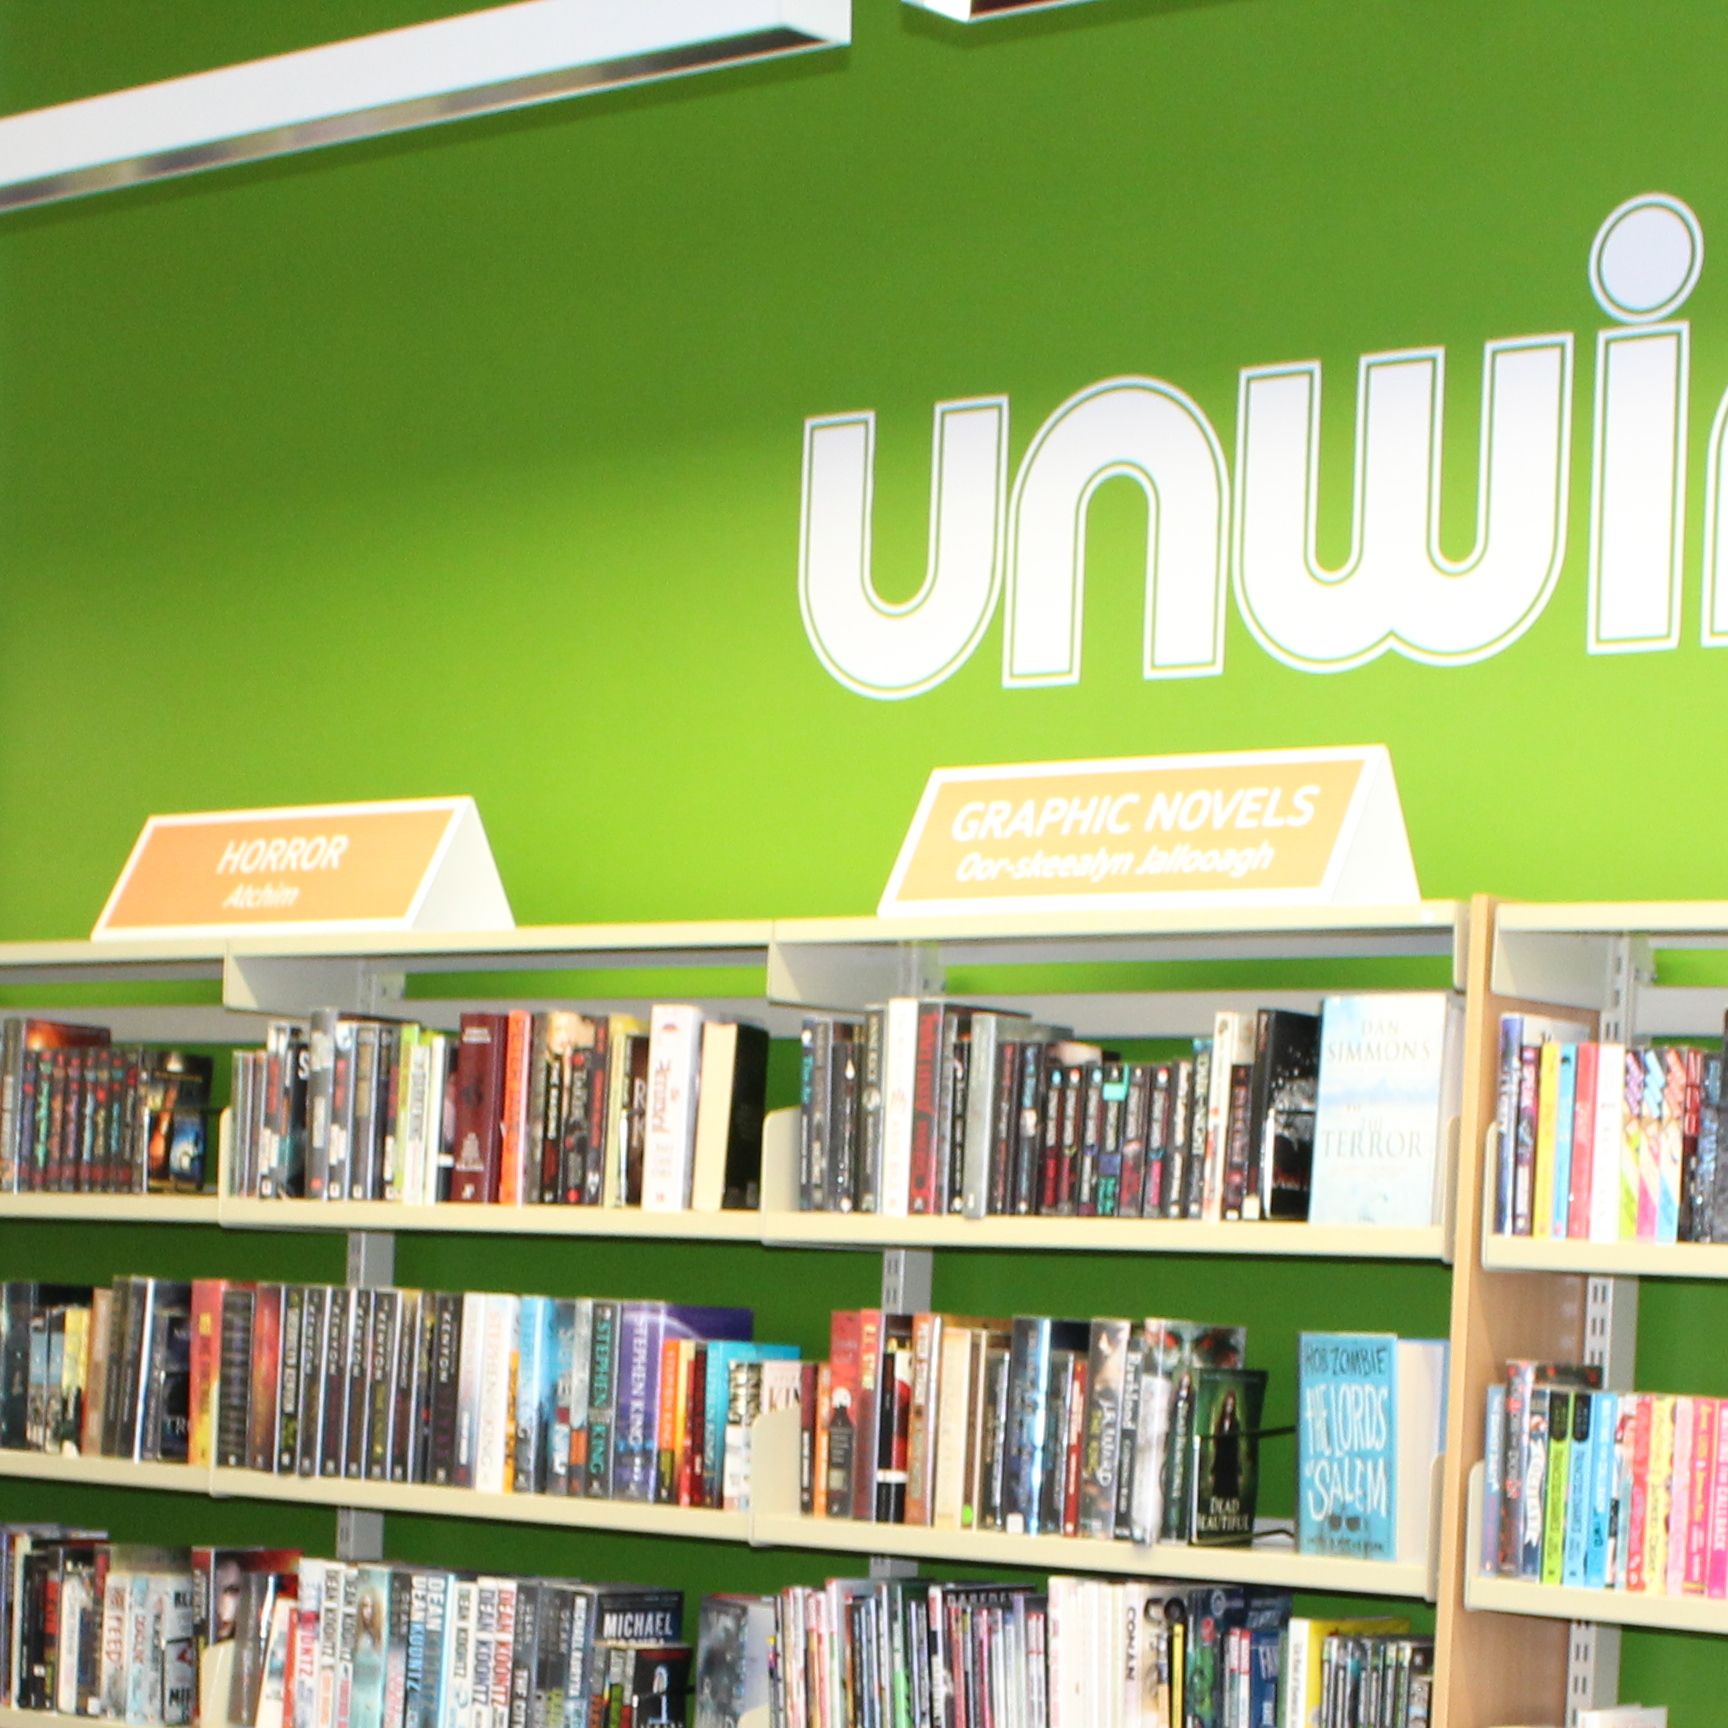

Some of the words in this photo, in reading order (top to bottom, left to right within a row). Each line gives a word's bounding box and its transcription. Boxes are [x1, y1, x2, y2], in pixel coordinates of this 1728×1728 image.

[950, 796, 1134, 844] GRAPHIC
[1145, 784, 1321, 833] NOVELS
[217, 833, 350, 874] HORROR
[1328, 1038, 1432, 1063] SIMMONS
[1321, 1131, 1425, 1160] TERROR
[590, 1319, 611, 1407] STEPHEN
[631, 1315, 653, 1395] STEPHEN
[1333, 1345, 1387, 1376] ZOMBIE
[629, 1400, 648, 1446] KING
[1331, 1382, 1388, 1454] LORDS
[589, 1423, 606, 1474] KING
[1308, 1455, 1388, 1523] SALEM
[603, 1611, 673, 1638] MICHAEL
[1123, 1605, 1139, 1680] CONAN
[472, 1640, 492, 1705] KOONTZ
[491, 1641, 511, 1707] KOONTZ
